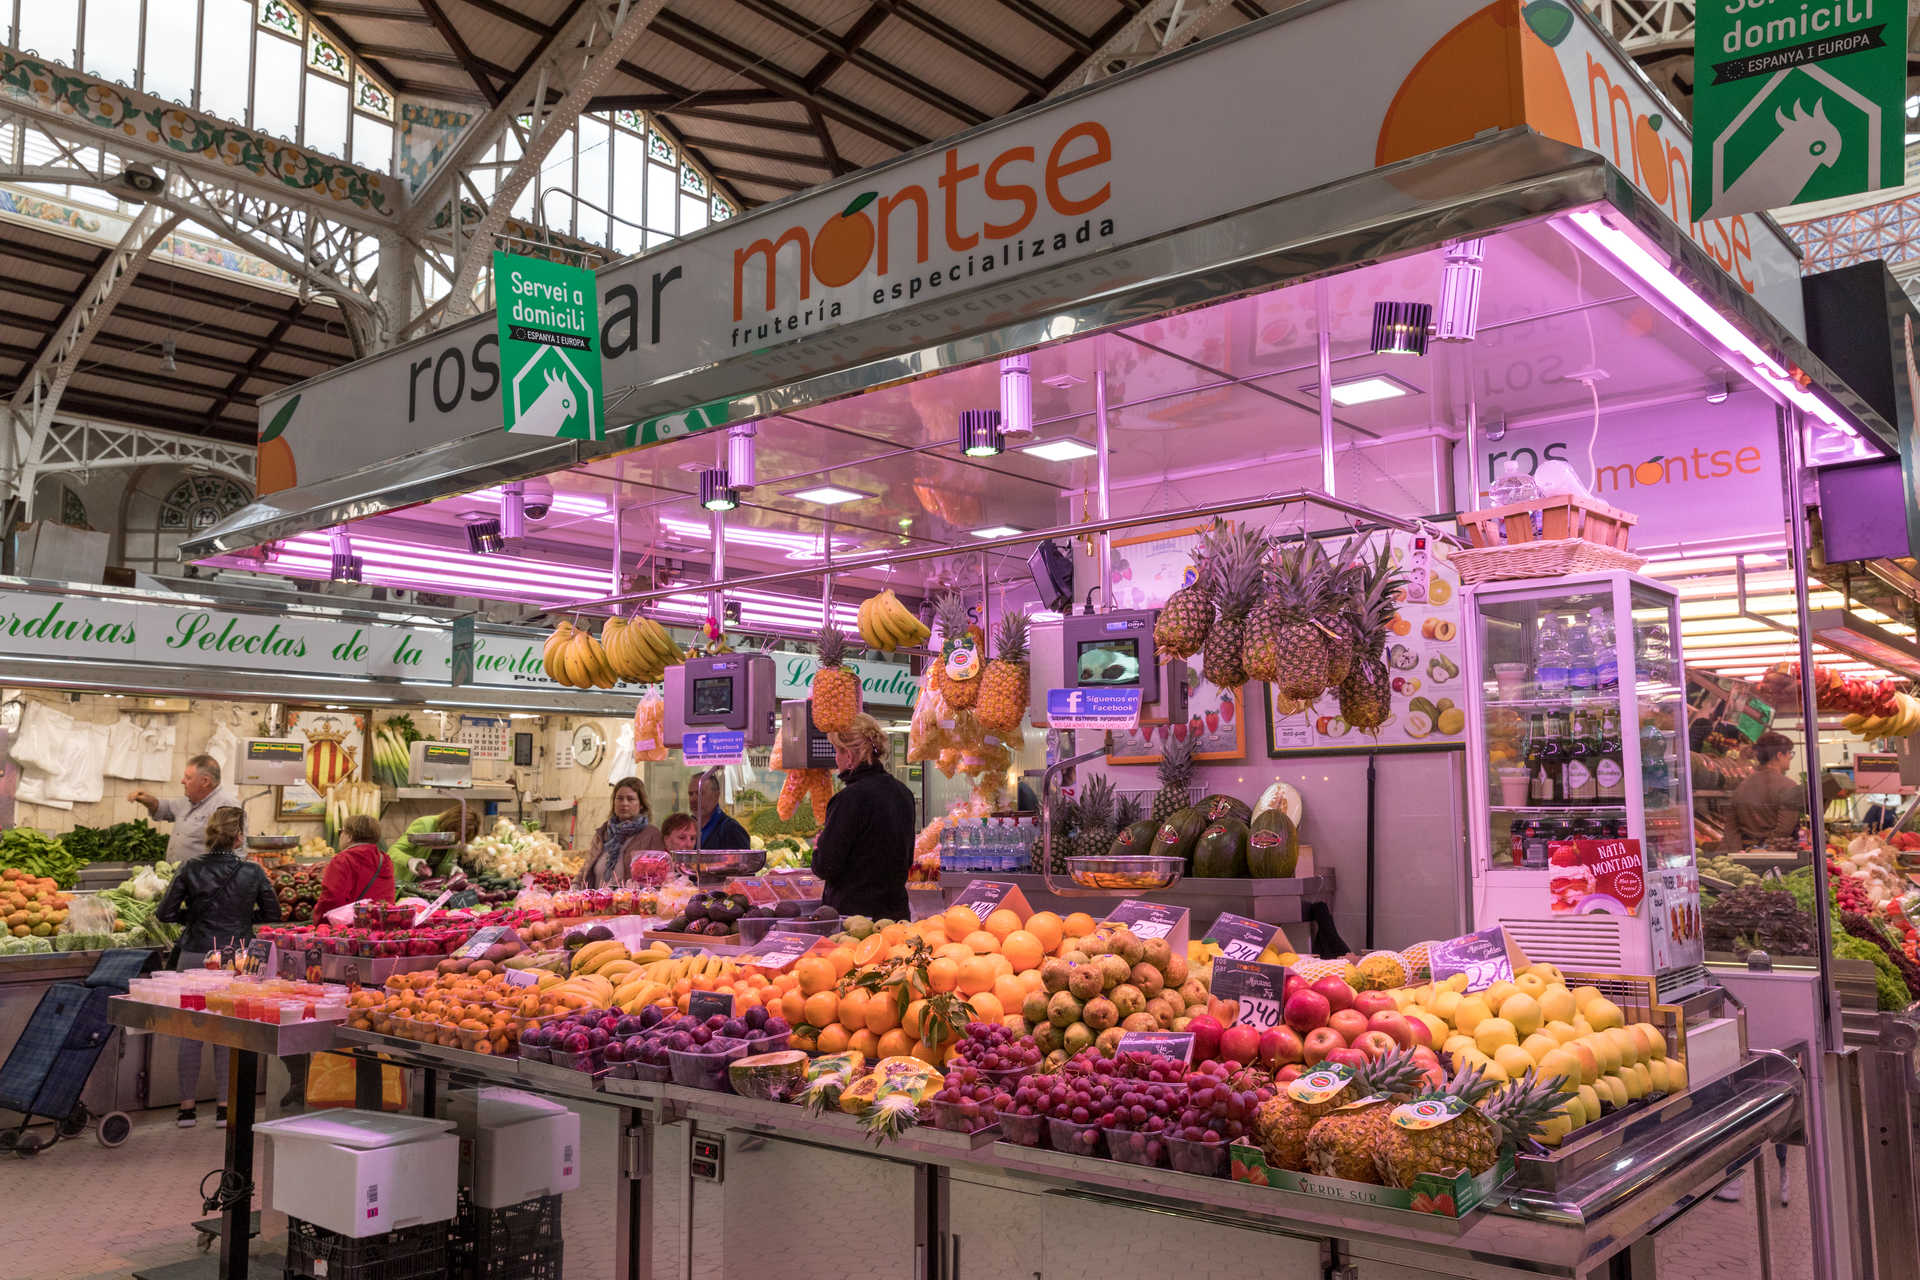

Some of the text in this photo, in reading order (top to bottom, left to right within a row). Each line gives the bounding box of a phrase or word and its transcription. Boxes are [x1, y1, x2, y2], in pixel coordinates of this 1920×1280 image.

[1747, 34, 1871, 73] ESPANYA I EUROPA
[511, 271, 584, 306] Servei a
[731, 217, 1115, 348] frutería especializada
[511, 299, 586, 332] domicili
[526, 329, 556, 344] ESPANYA
[560, 335, 586, 348] EUROPA
[165, 611, 308, 658] Selectas
[331, 629, 369, 662] de
[392, 634, 424, 667] la
[1092, 704, 1133, 712] Facebook
[1591, 853, 1642, 877] MONTADA
[1597, 842, 1626, 859] NATA
[1299, 1179, 1378, 1204] VERDE SUR
